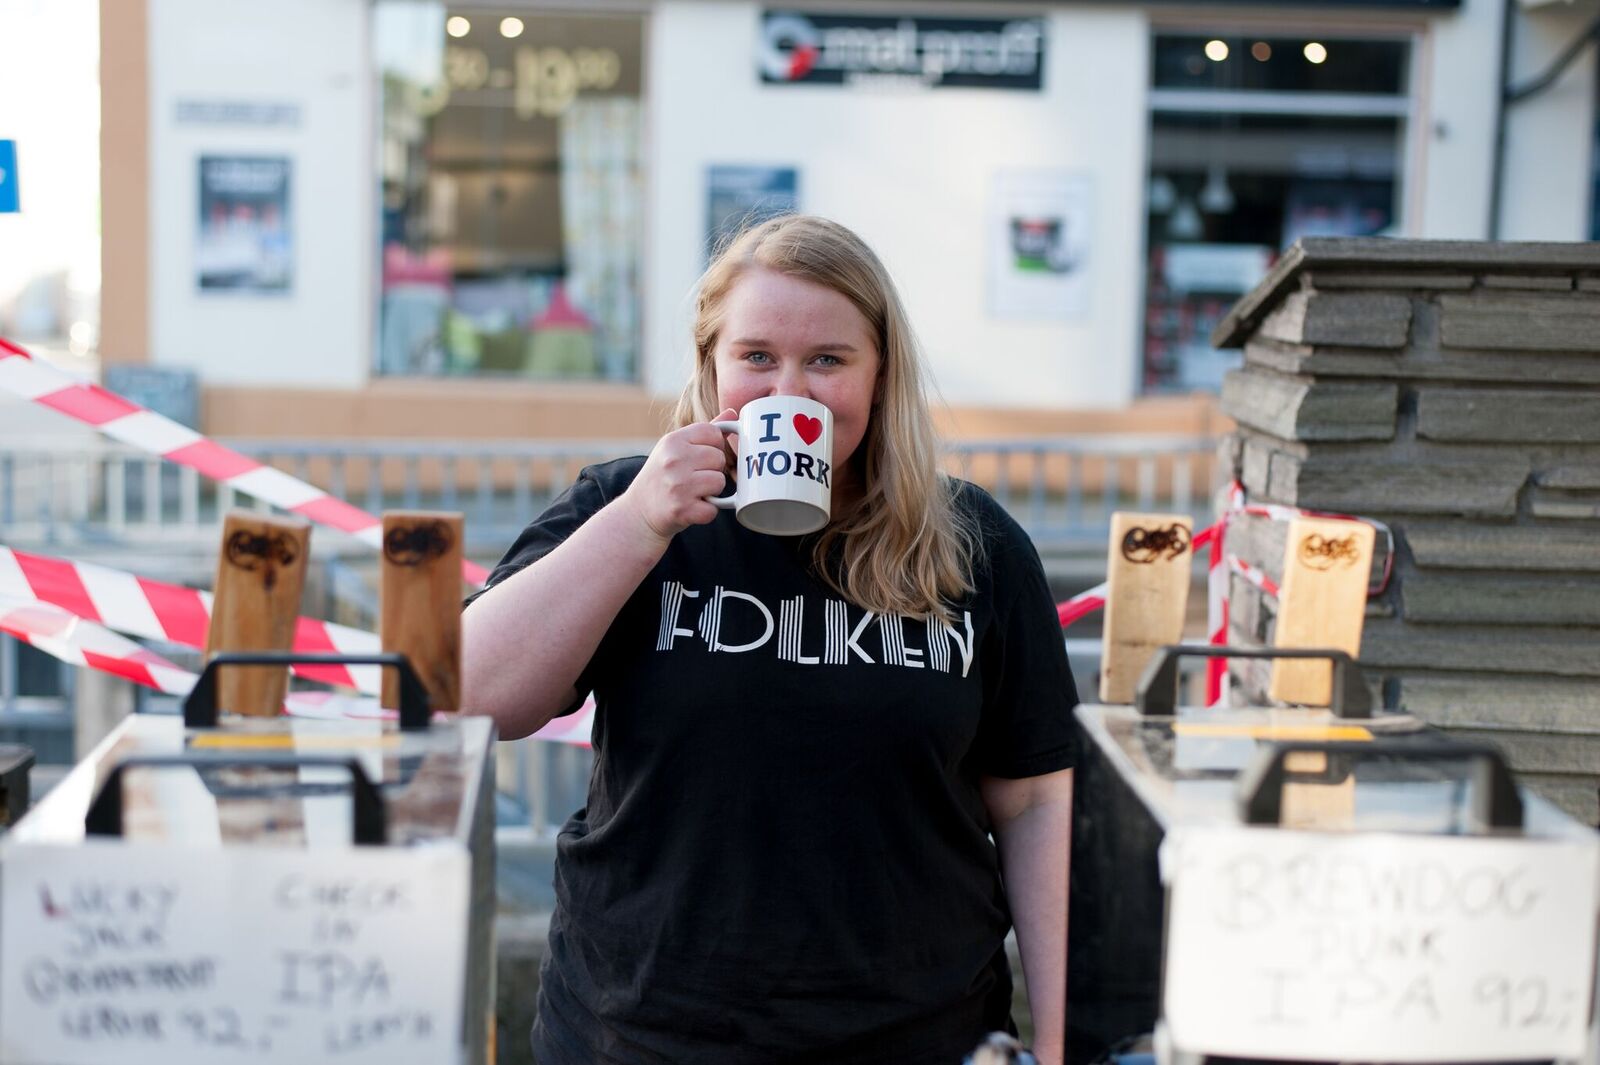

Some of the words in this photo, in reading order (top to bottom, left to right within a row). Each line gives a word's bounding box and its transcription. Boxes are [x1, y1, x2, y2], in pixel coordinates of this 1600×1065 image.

[759, 413, 781, 442] I
[745, 450, 830, 489] WORK
[656, 581, 974, 678] FOLKEN
[1213, 850, 1545, 936] BREWDOG
[1301, 922, 1448, 970] PUNK
[277, 950, 392, 1008] IPA
